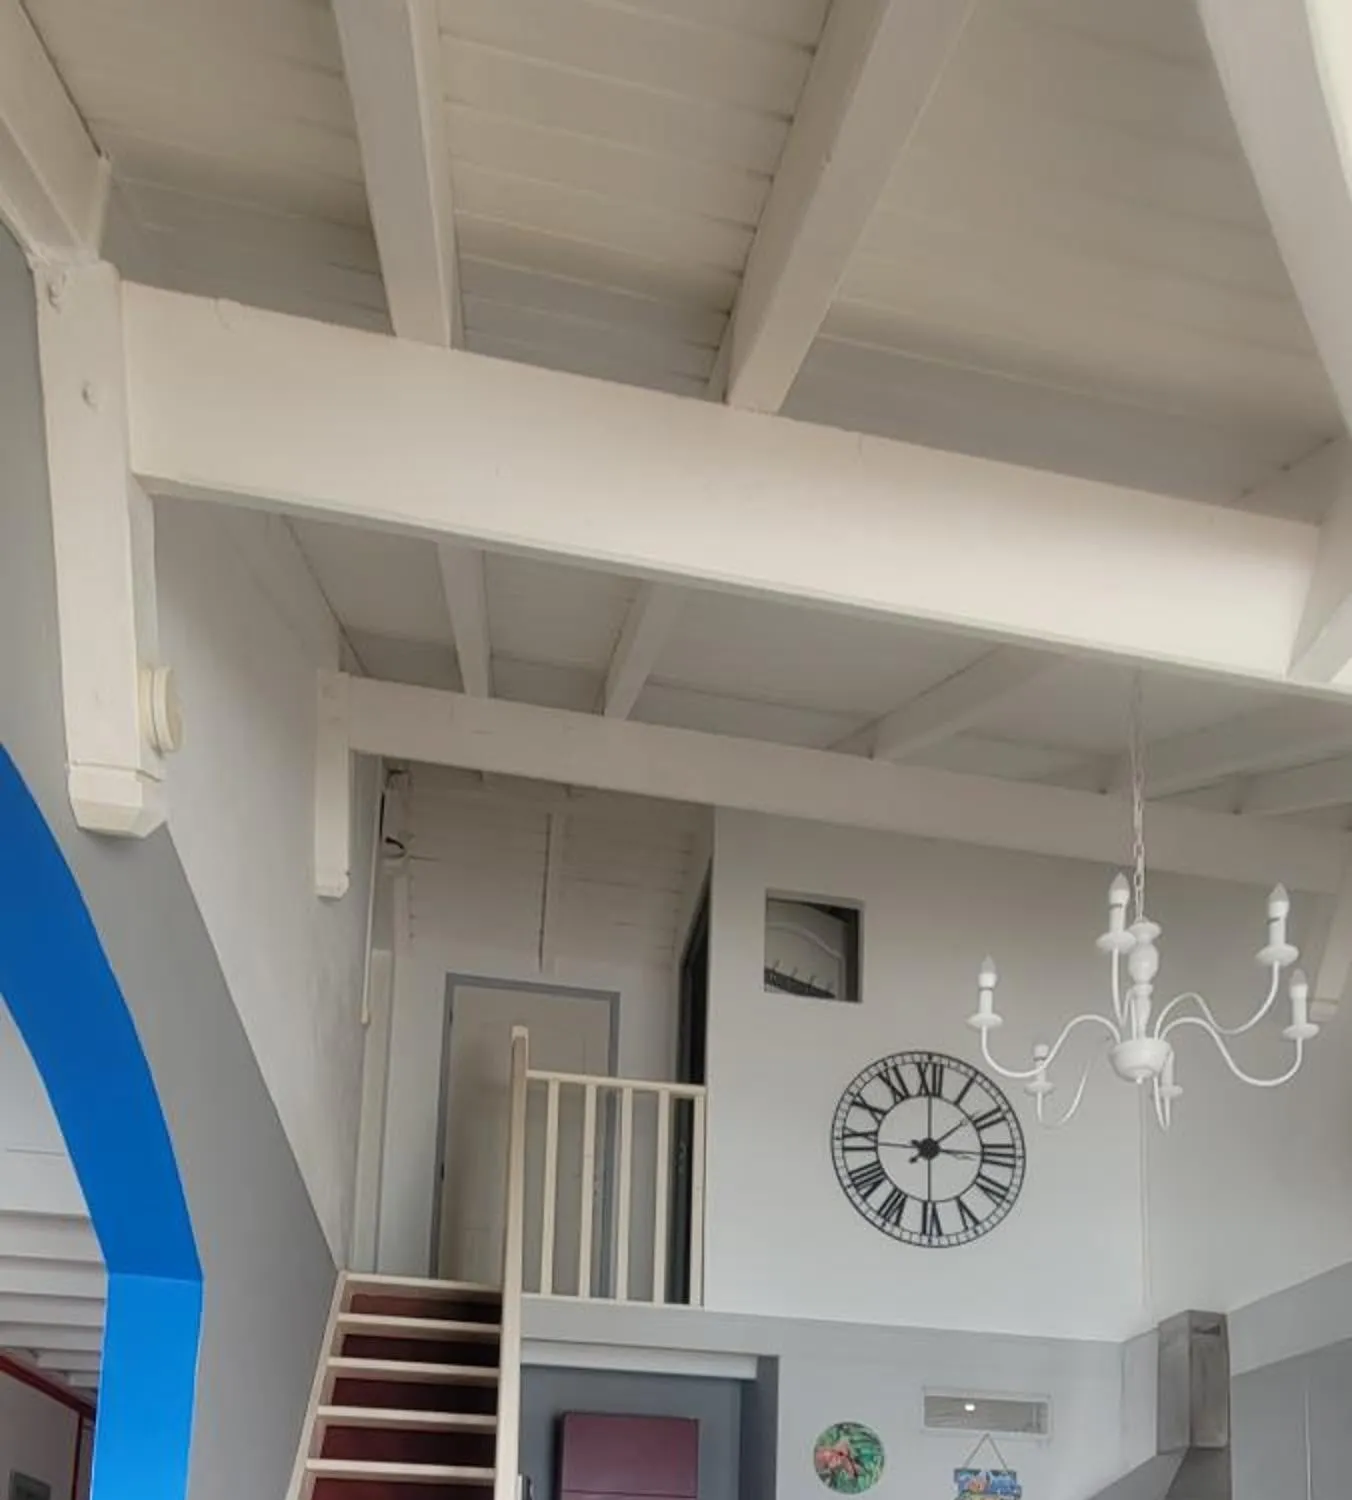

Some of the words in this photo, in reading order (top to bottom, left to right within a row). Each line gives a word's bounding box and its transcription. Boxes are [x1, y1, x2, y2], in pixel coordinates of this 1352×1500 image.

[849, 1091, 887, 1124] X
[971, 1104, 1006, 1132] II
[842, 1125, 878, 1151] IX
[981, 1143, 1015, 1168] III
